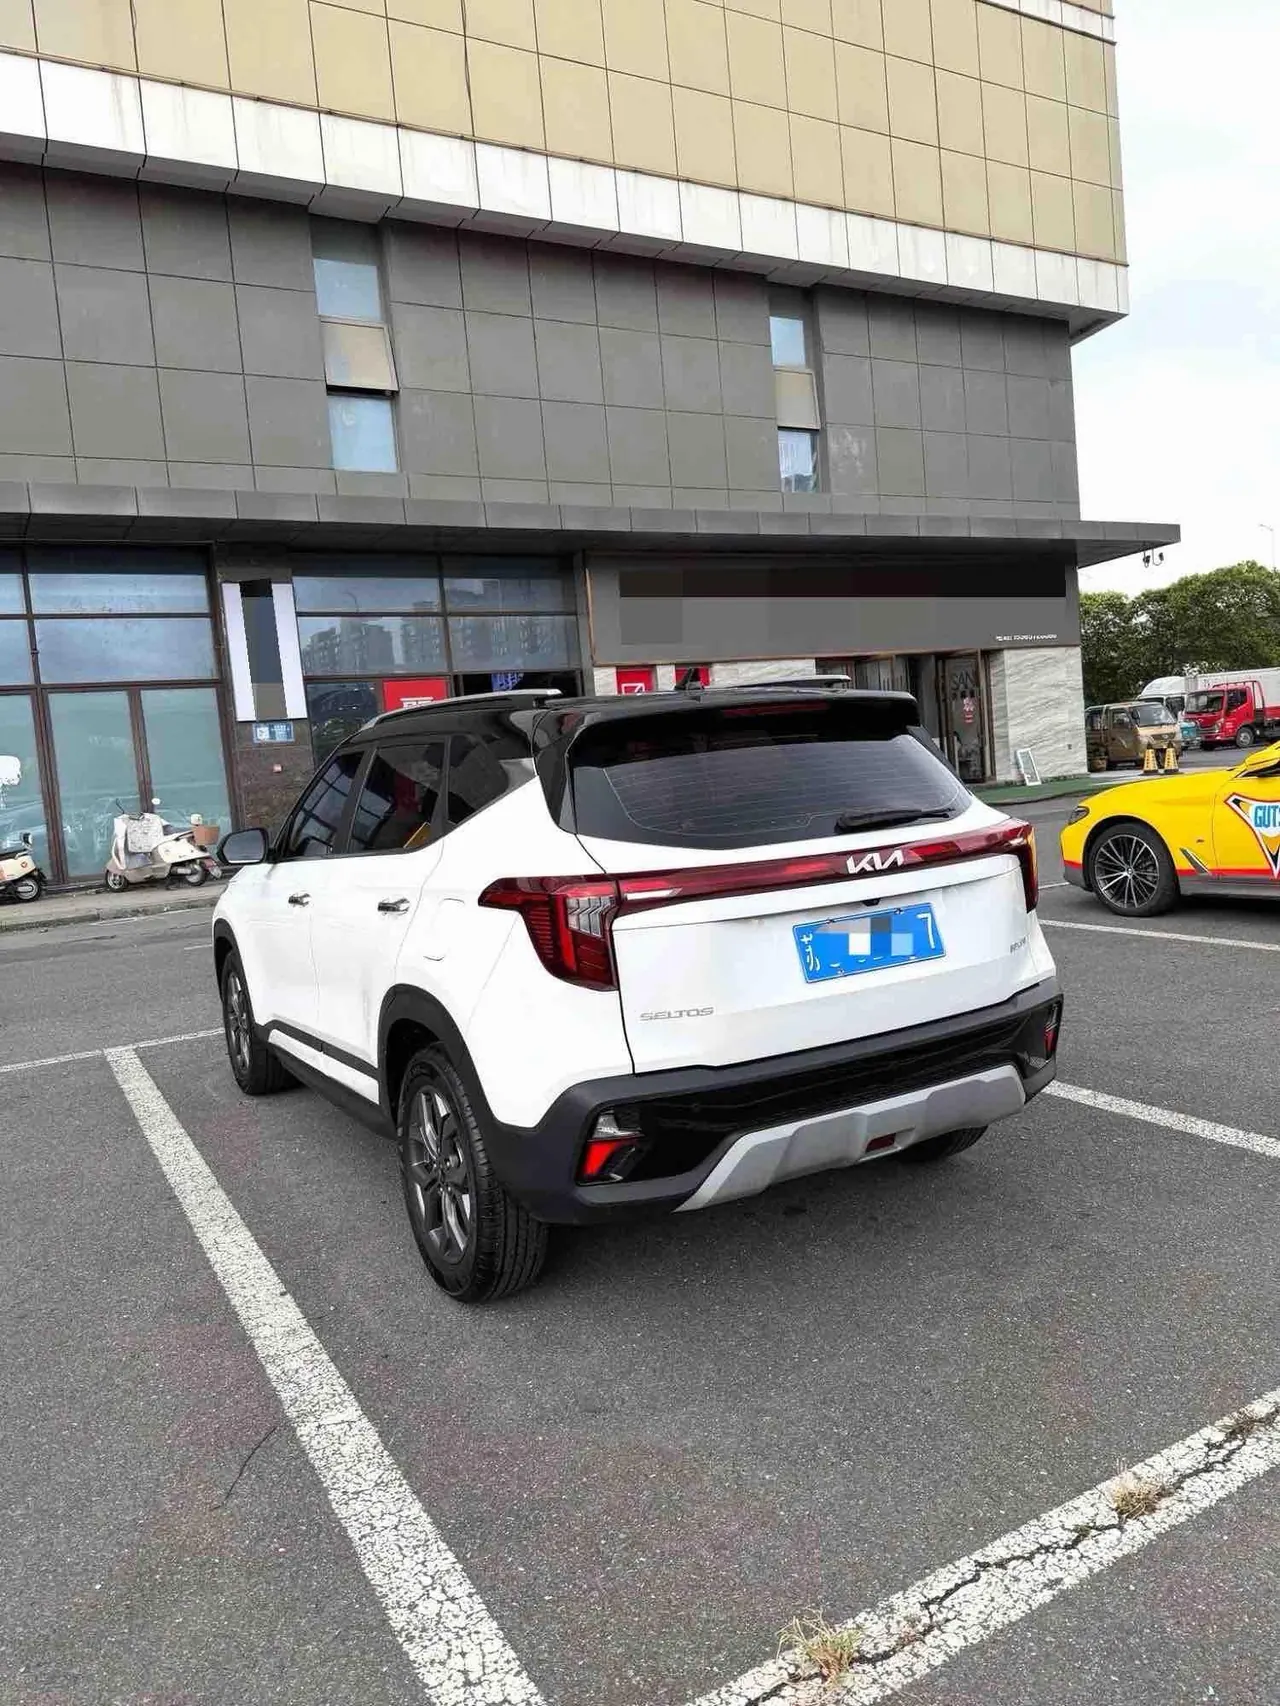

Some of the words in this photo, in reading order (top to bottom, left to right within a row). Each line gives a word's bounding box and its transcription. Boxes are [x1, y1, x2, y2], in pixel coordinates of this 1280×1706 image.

[1254, 804, 1280, 828] GUT
[846, 849, 904, 874] KIA
[639, 1006, 715, 1021] SELTOS
